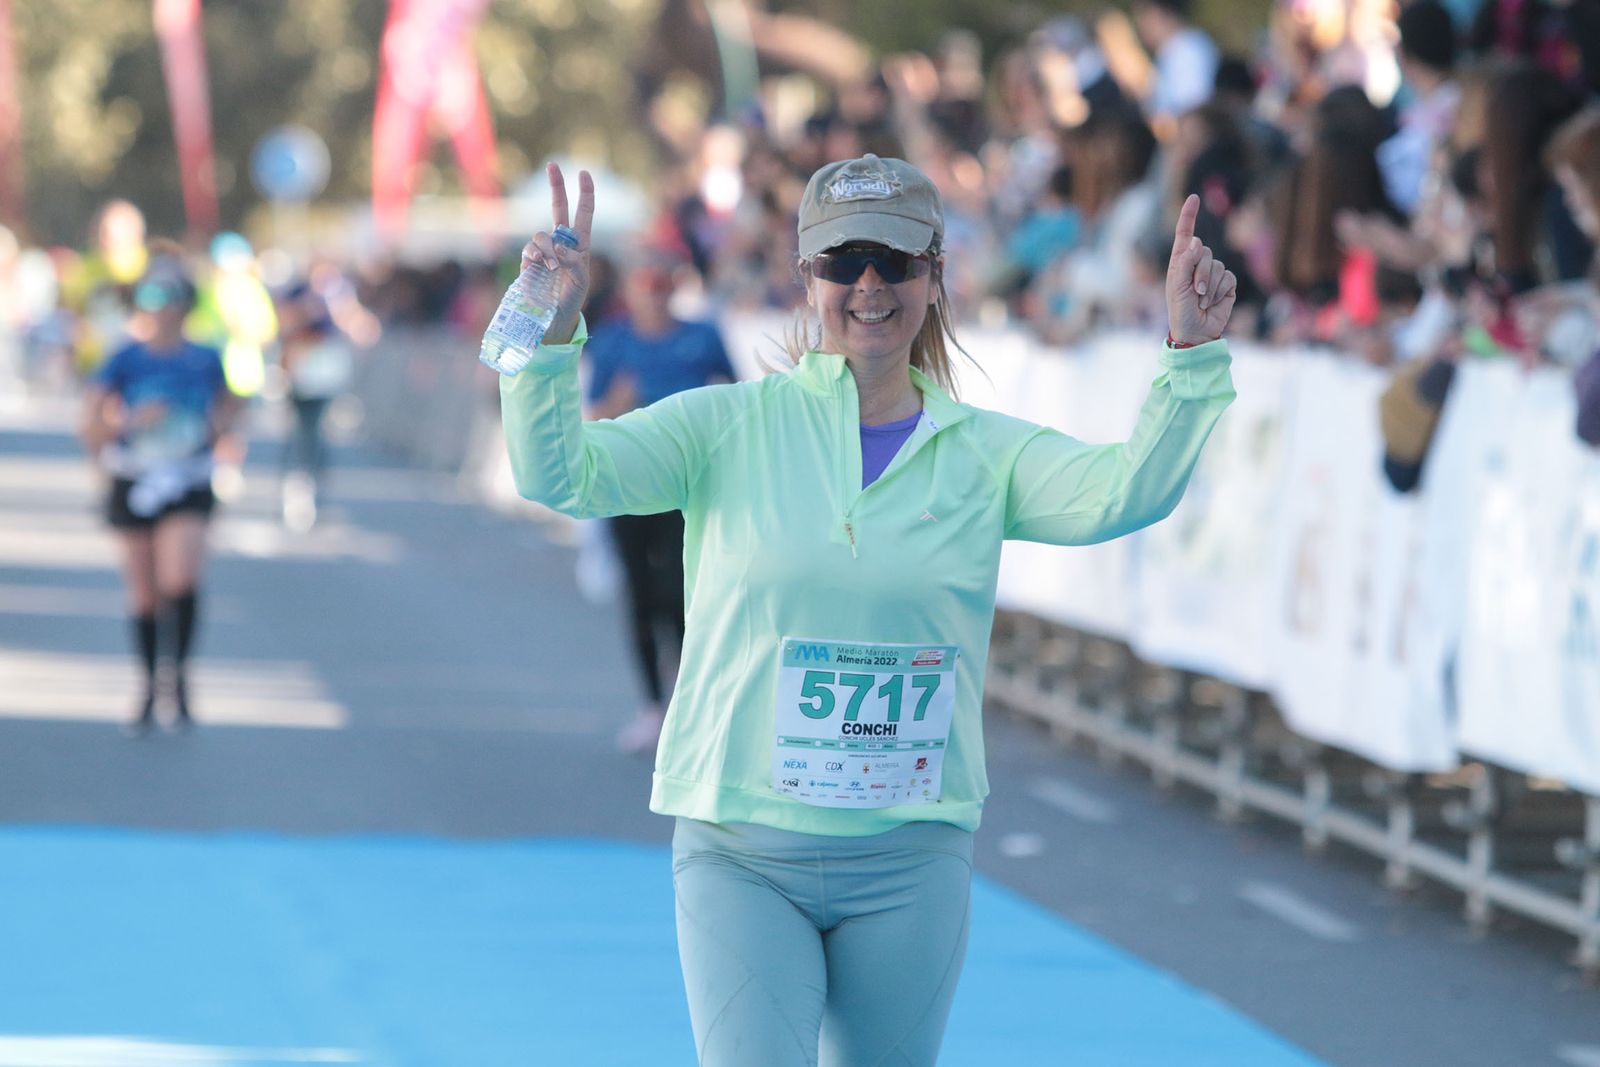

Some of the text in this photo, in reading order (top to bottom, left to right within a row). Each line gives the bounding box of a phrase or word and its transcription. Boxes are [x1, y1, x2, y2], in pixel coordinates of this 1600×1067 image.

[829, 178, 891, 198] Norway
[836, 647, 900, 657] Medio Maratón
[836, 655, 872, 666] Almería
[798, 670, 942, 723] 5717
[841, 722, 898, 736] CONCHI
[783, 759, 808, 770] NEXA
[825, 760, 846, 772] CDX
[782, 778, 800, 788] CASI
